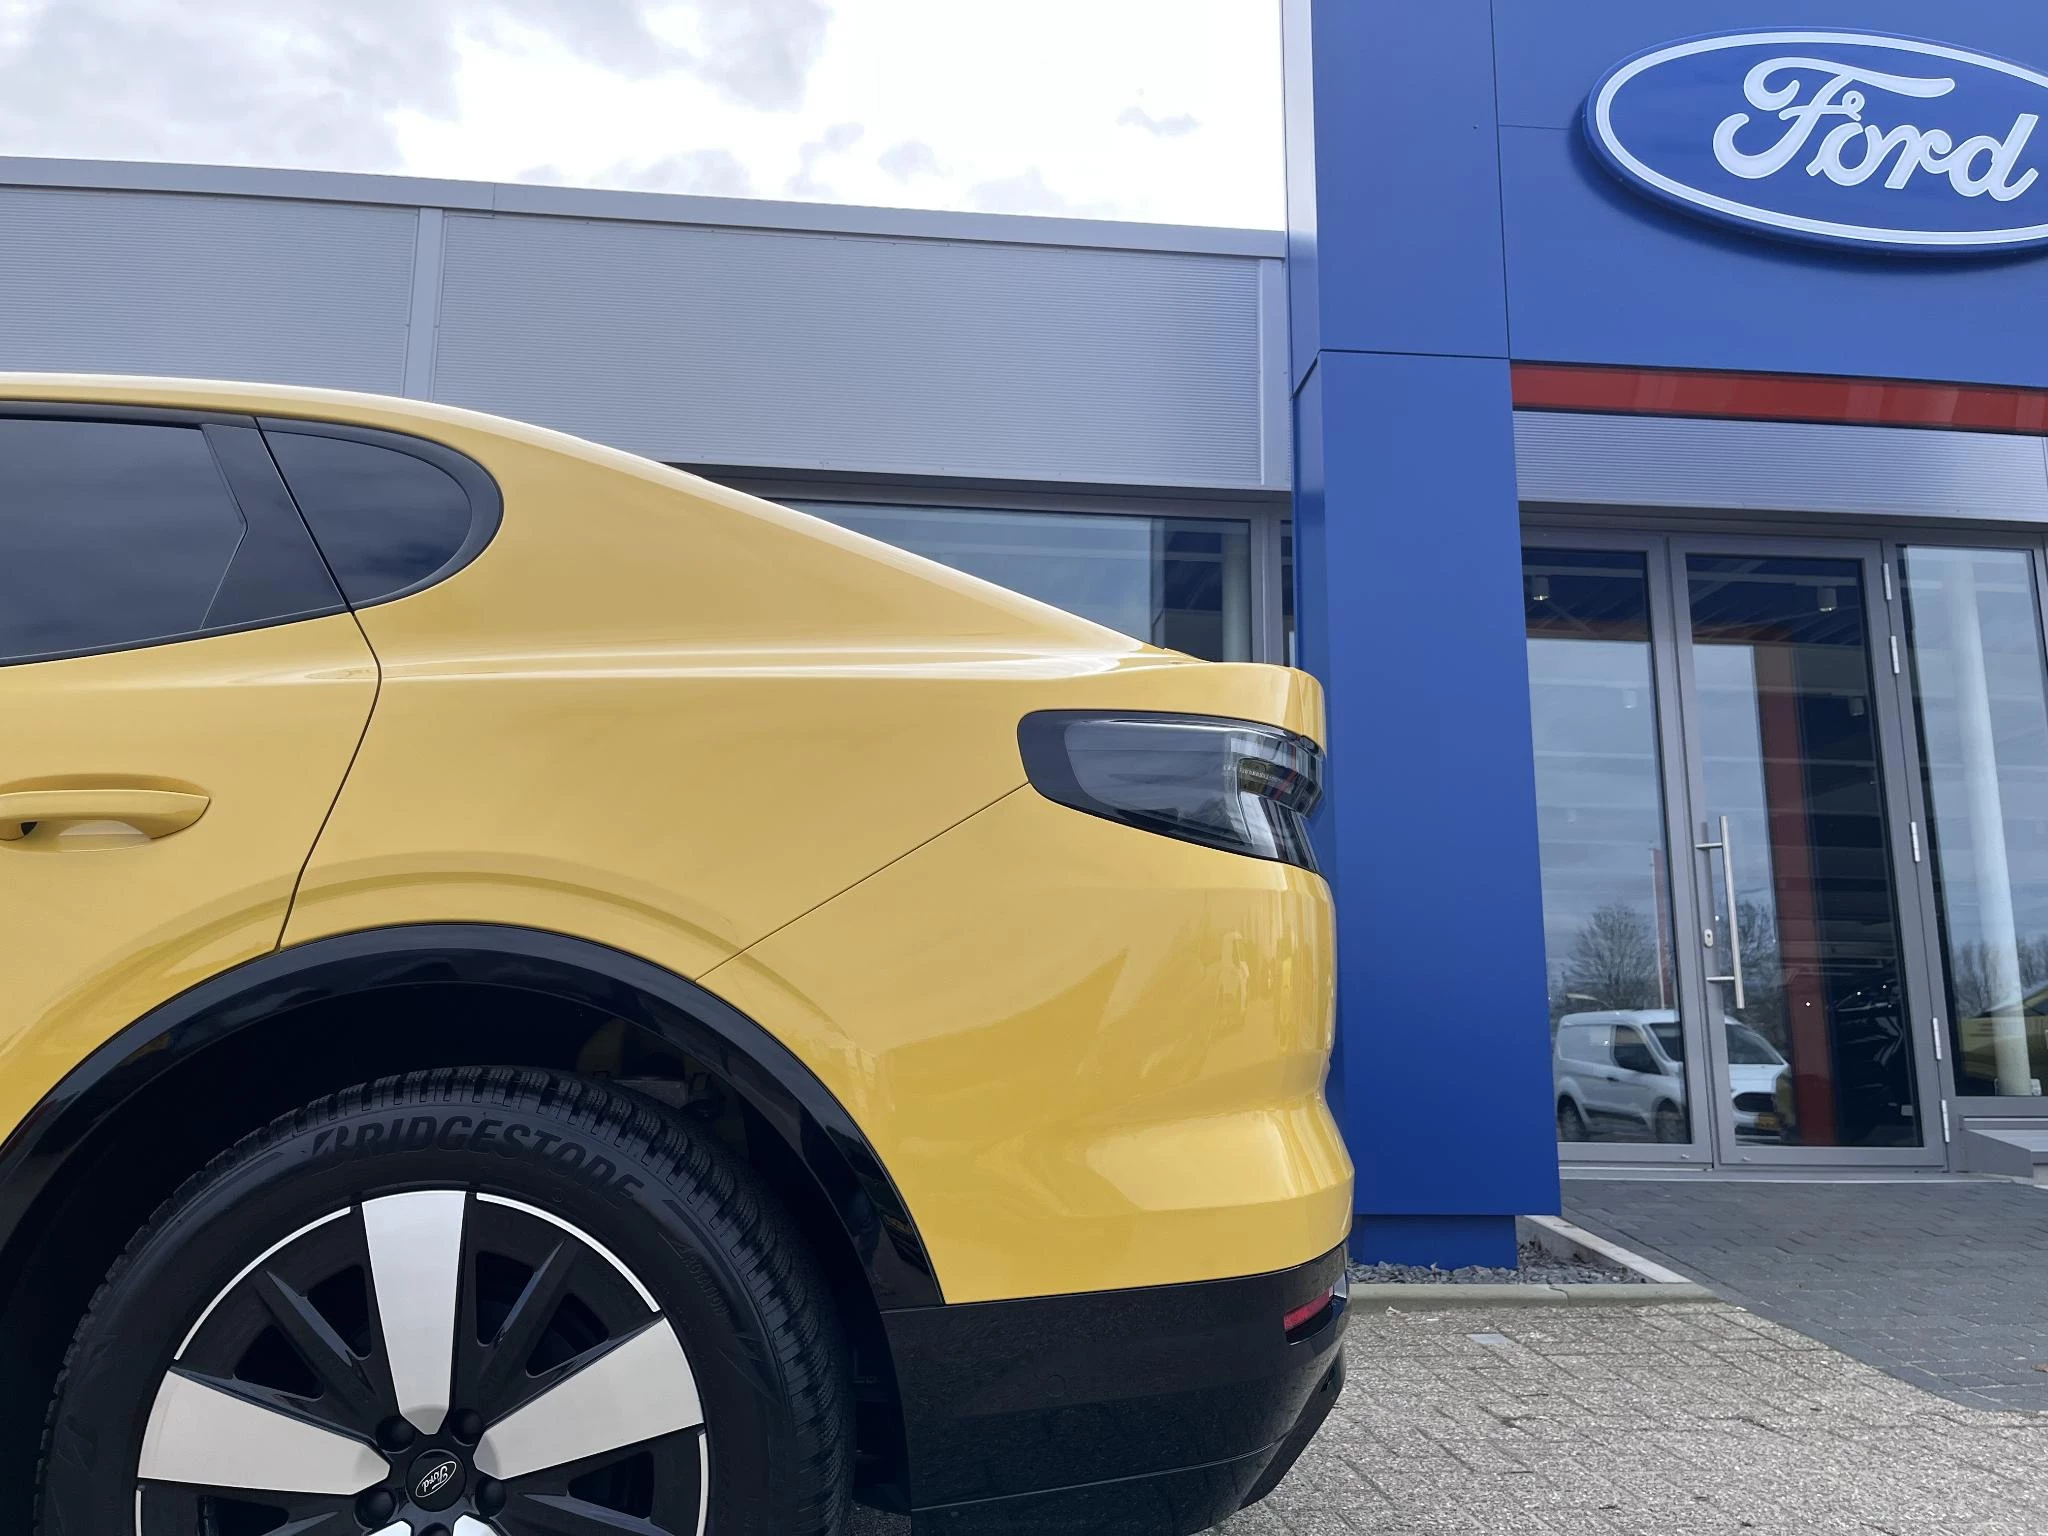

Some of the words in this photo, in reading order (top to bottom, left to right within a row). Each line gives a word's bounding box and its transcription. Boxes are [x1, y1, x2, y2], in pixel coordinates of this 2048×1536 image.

[1712, 56, 2039, 202] Ford
[310, 1115, 646, 1207] BRIDGESTONE
[421, 1465, 449, 1493] Ford
